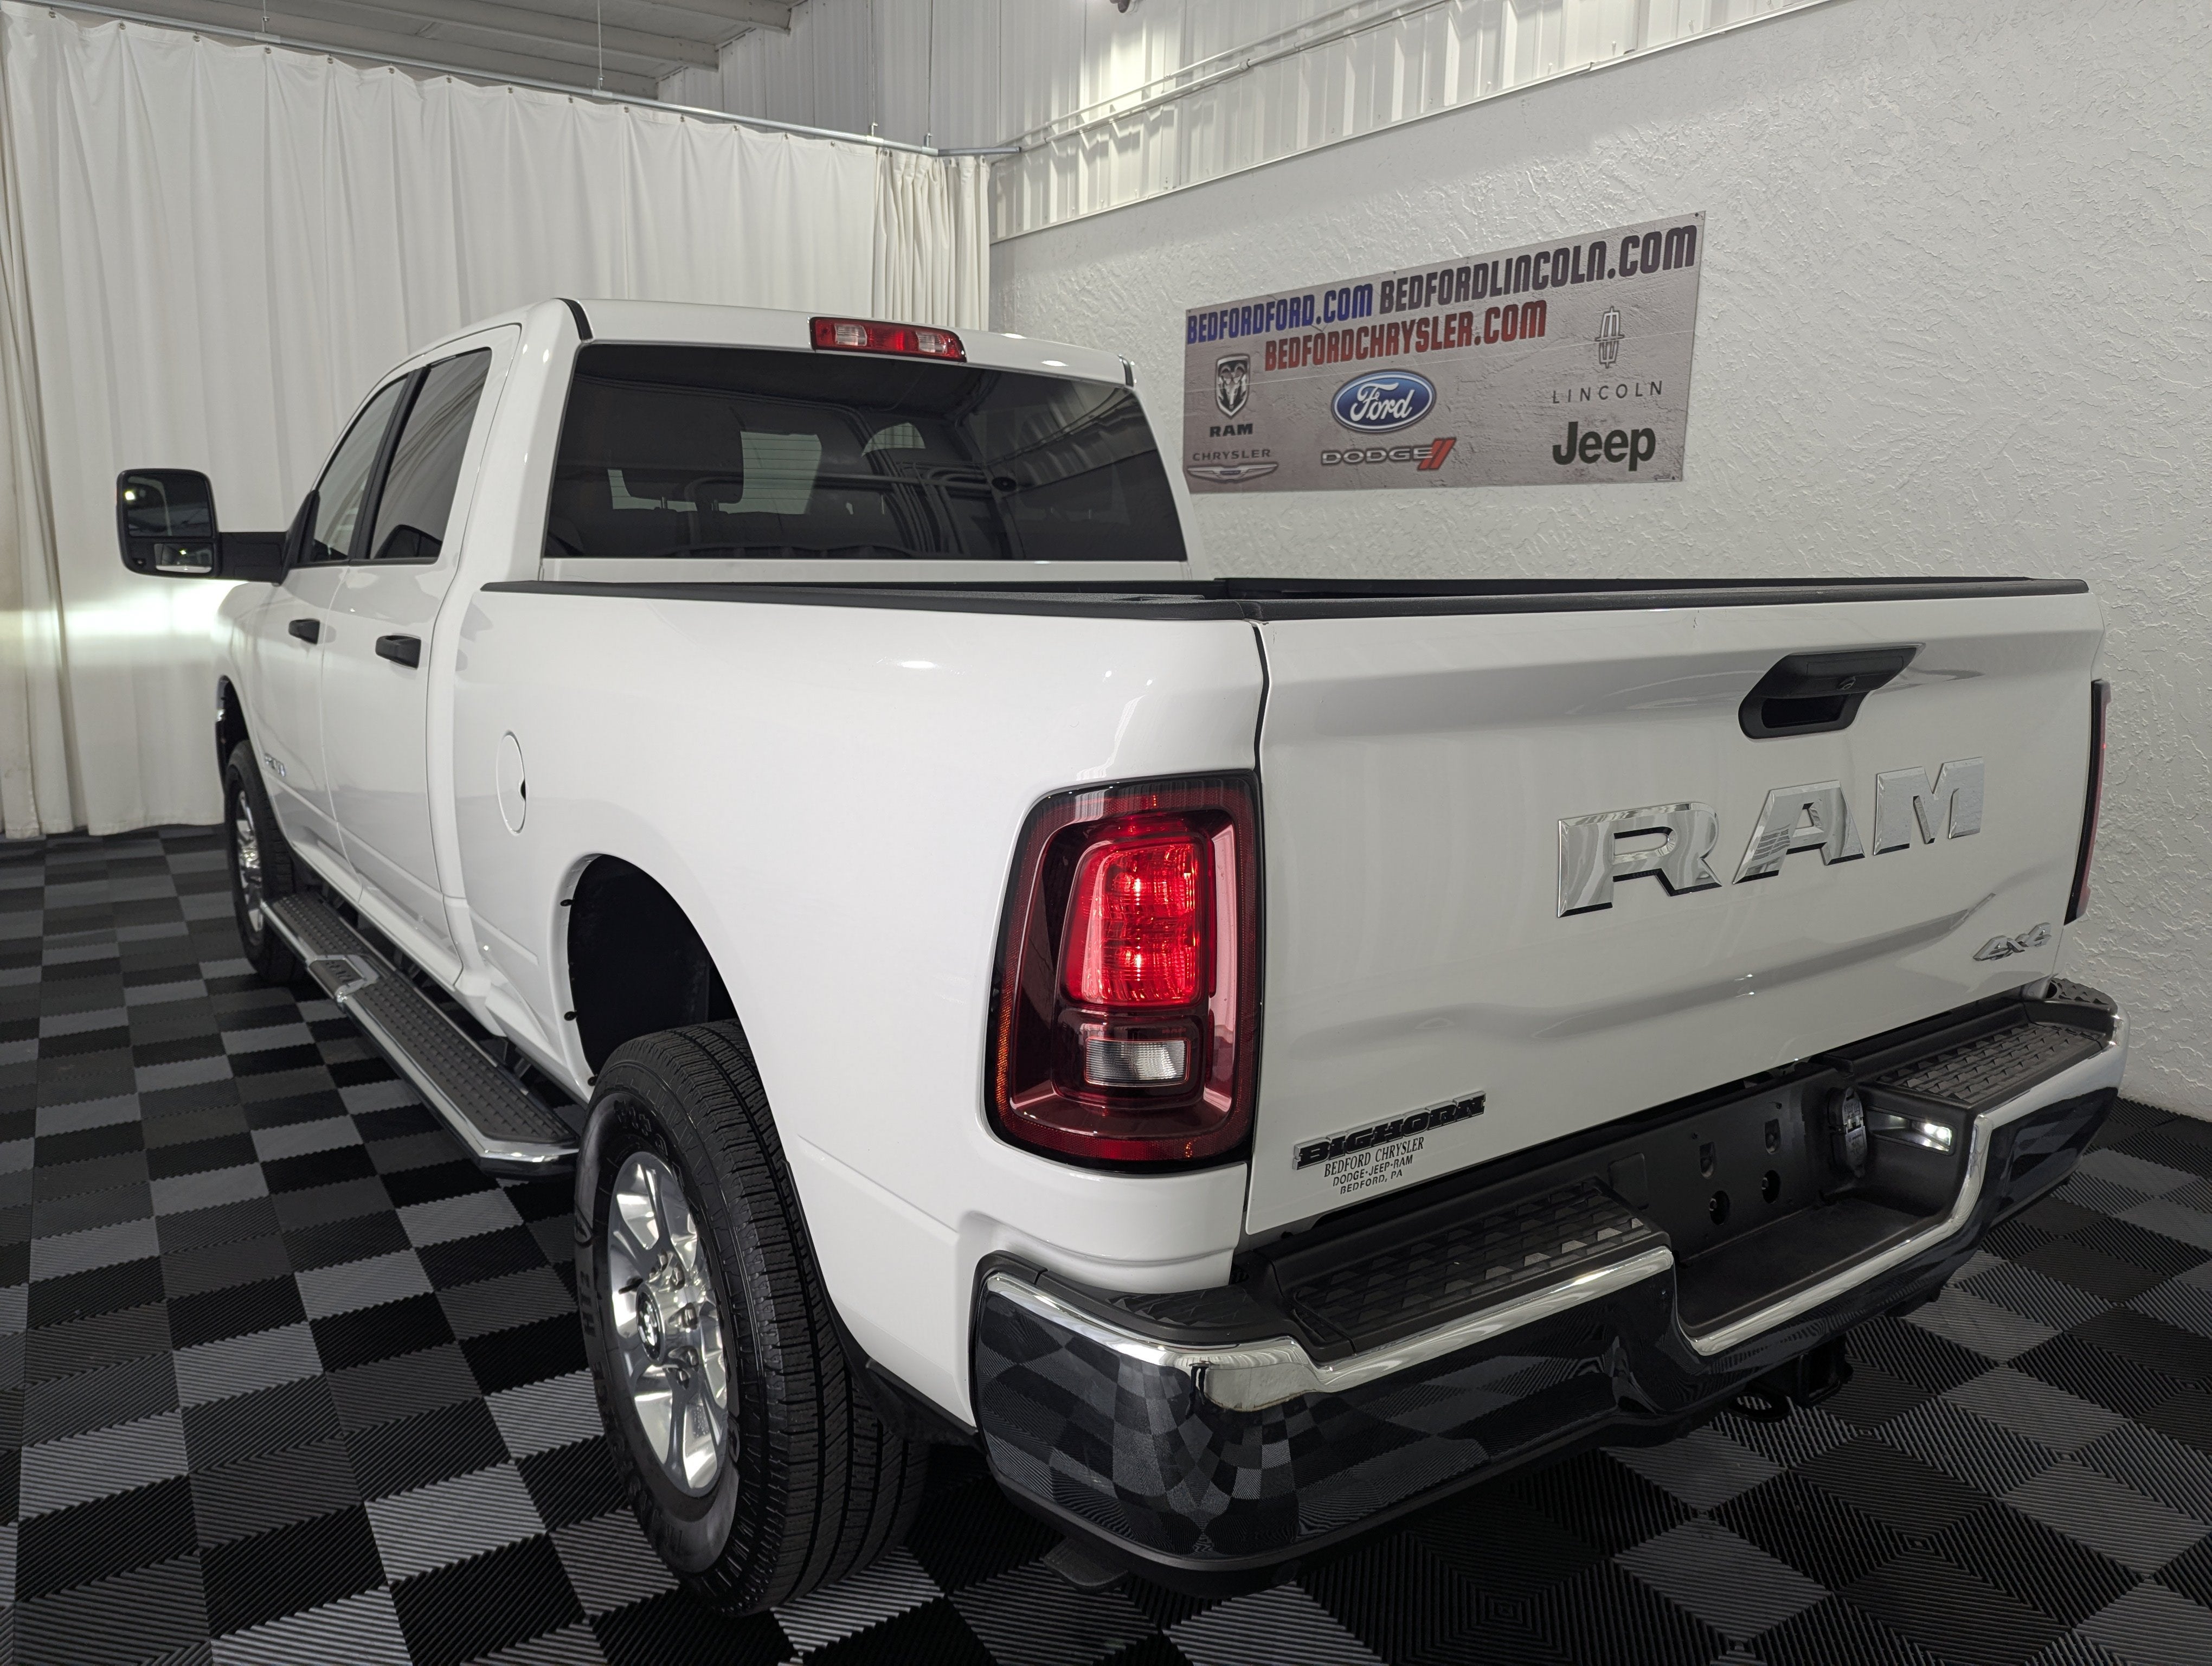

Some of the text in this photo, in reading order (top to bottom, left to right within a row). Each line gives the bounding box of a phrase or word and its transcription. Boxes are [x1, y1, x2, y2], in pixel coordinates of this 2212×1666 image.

[1187, 284, 1373, 345] BEDFORDFORD.COM
[1265, 300, 1547, 372] BEDFORDCHRYSLER.COM
[1350, 381, 1414, 422] Ford
[1553, 380, 1663, 405] LINCOLN
[1210, 423, 1253, 438] RAM
[1552, 421, 1656, 472] Jeep
[1193, 448, 1272, 463] CHRYSLER
[1321, 446, 1433, 466] DODGE
[1557, 757, 1984, 919] RAM
[1323, 1136, 1425, 1178] BEDFORD CHRYSLER
[1340, 1169, 1403, 1195] BEDFORD, PA
